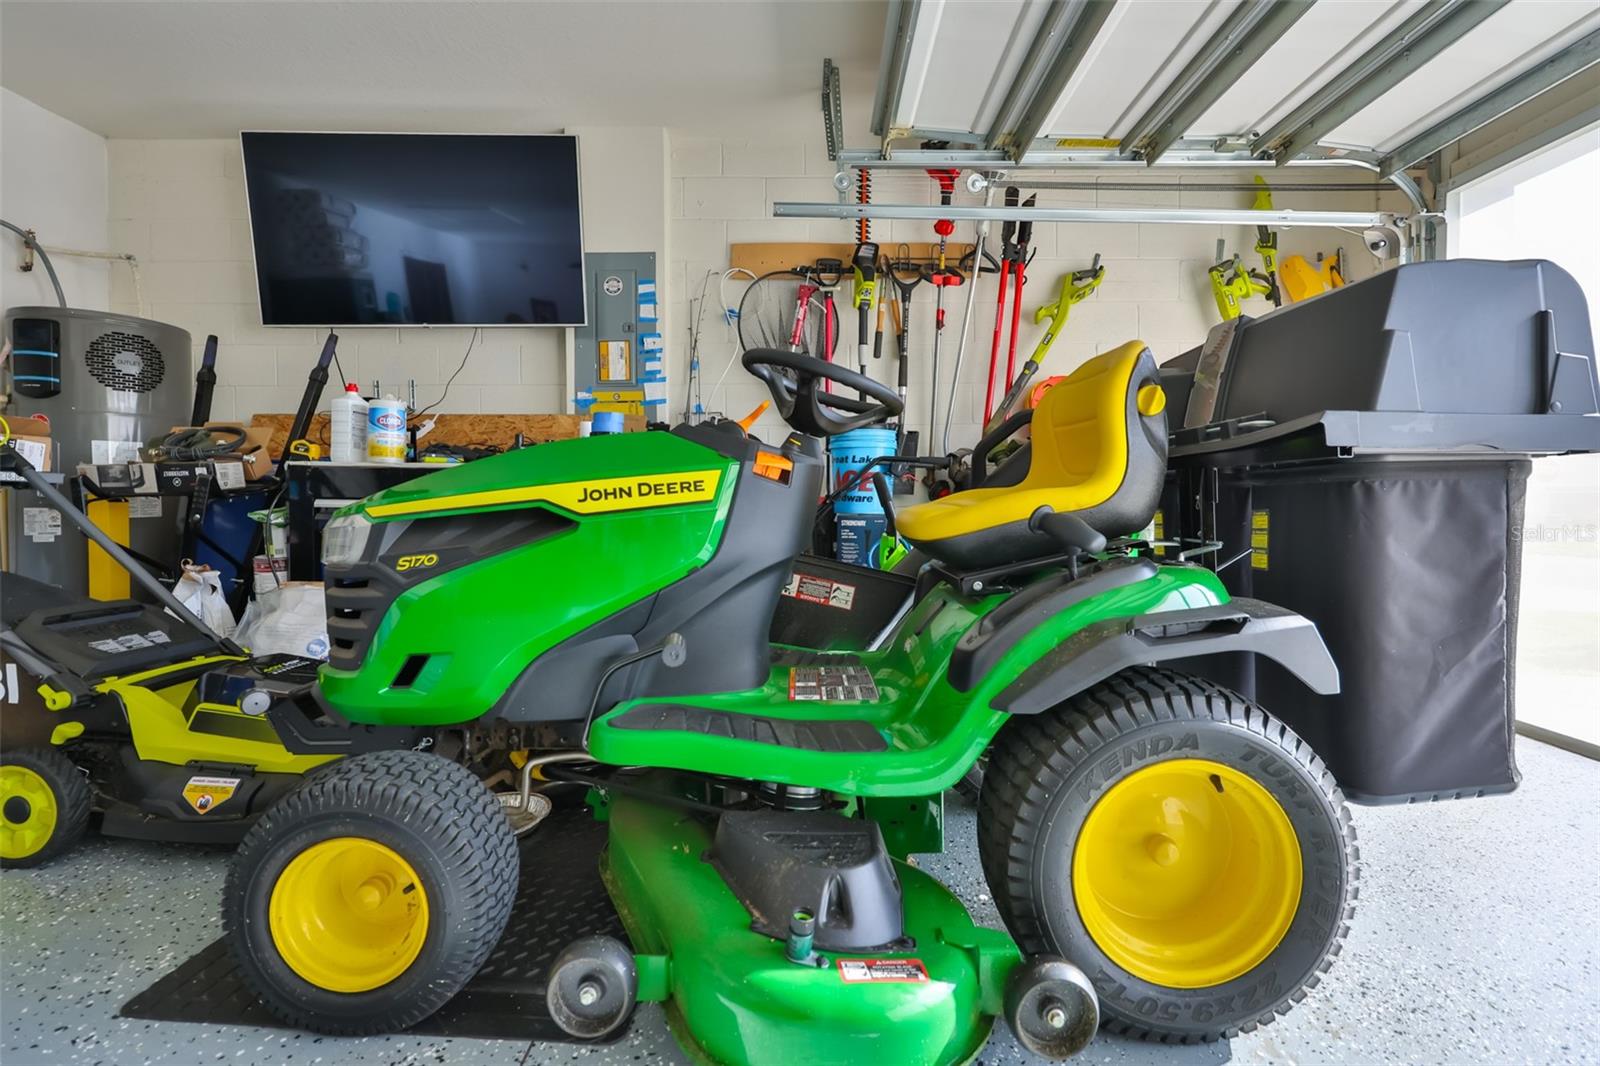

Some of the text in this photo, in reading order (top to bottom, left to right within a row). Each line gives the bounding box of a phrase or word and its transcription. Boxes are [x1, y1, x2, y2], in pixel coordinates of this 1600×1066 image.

[577, 480, 705, 503] JOHN DEERE
[395, 553, 438, 571] S170
[1079, 732, 1200, 804] KENDA
